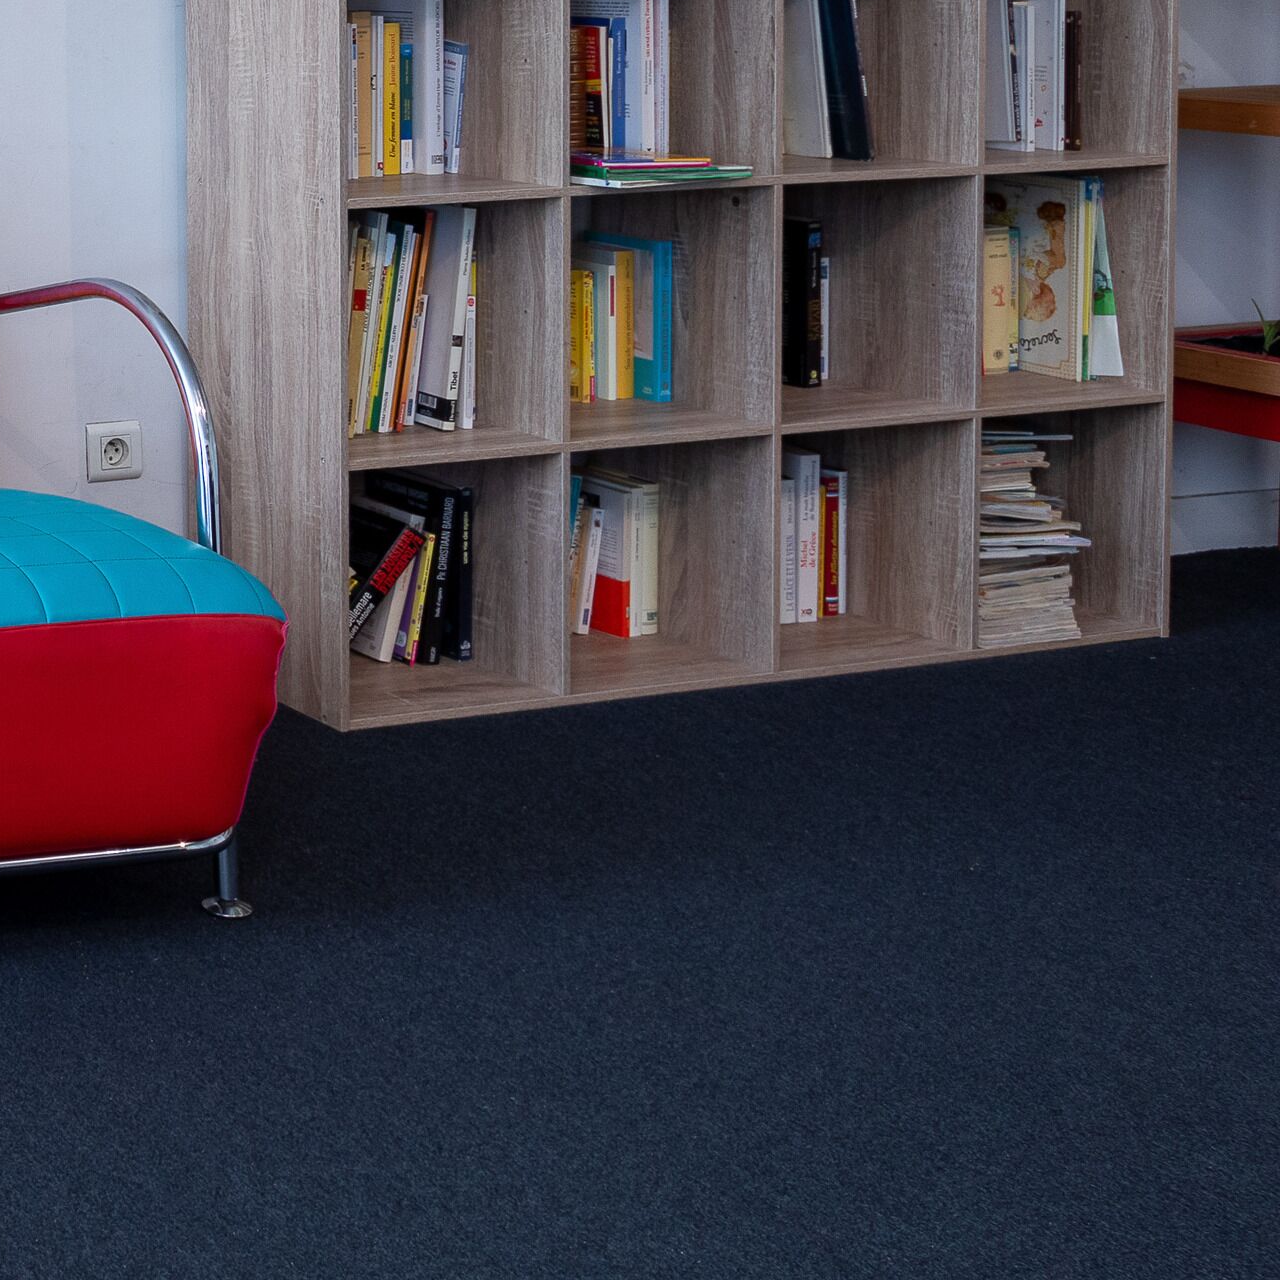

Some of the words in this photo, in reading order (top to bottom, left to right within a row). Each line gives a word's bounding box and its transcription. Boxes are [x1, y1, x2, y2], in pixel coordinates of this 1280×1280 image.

[449, 371, 459, 391] Tibet
[443, 497, 454, 529] BARNARD
[438, 531, 450, 571] CHRISTIAAN
[800, 540, 808, 568] Michel
[808, 557, 816, 567] de
[354, 603, 375, 626] Antoine
[786, 602, 794, 611] LA
